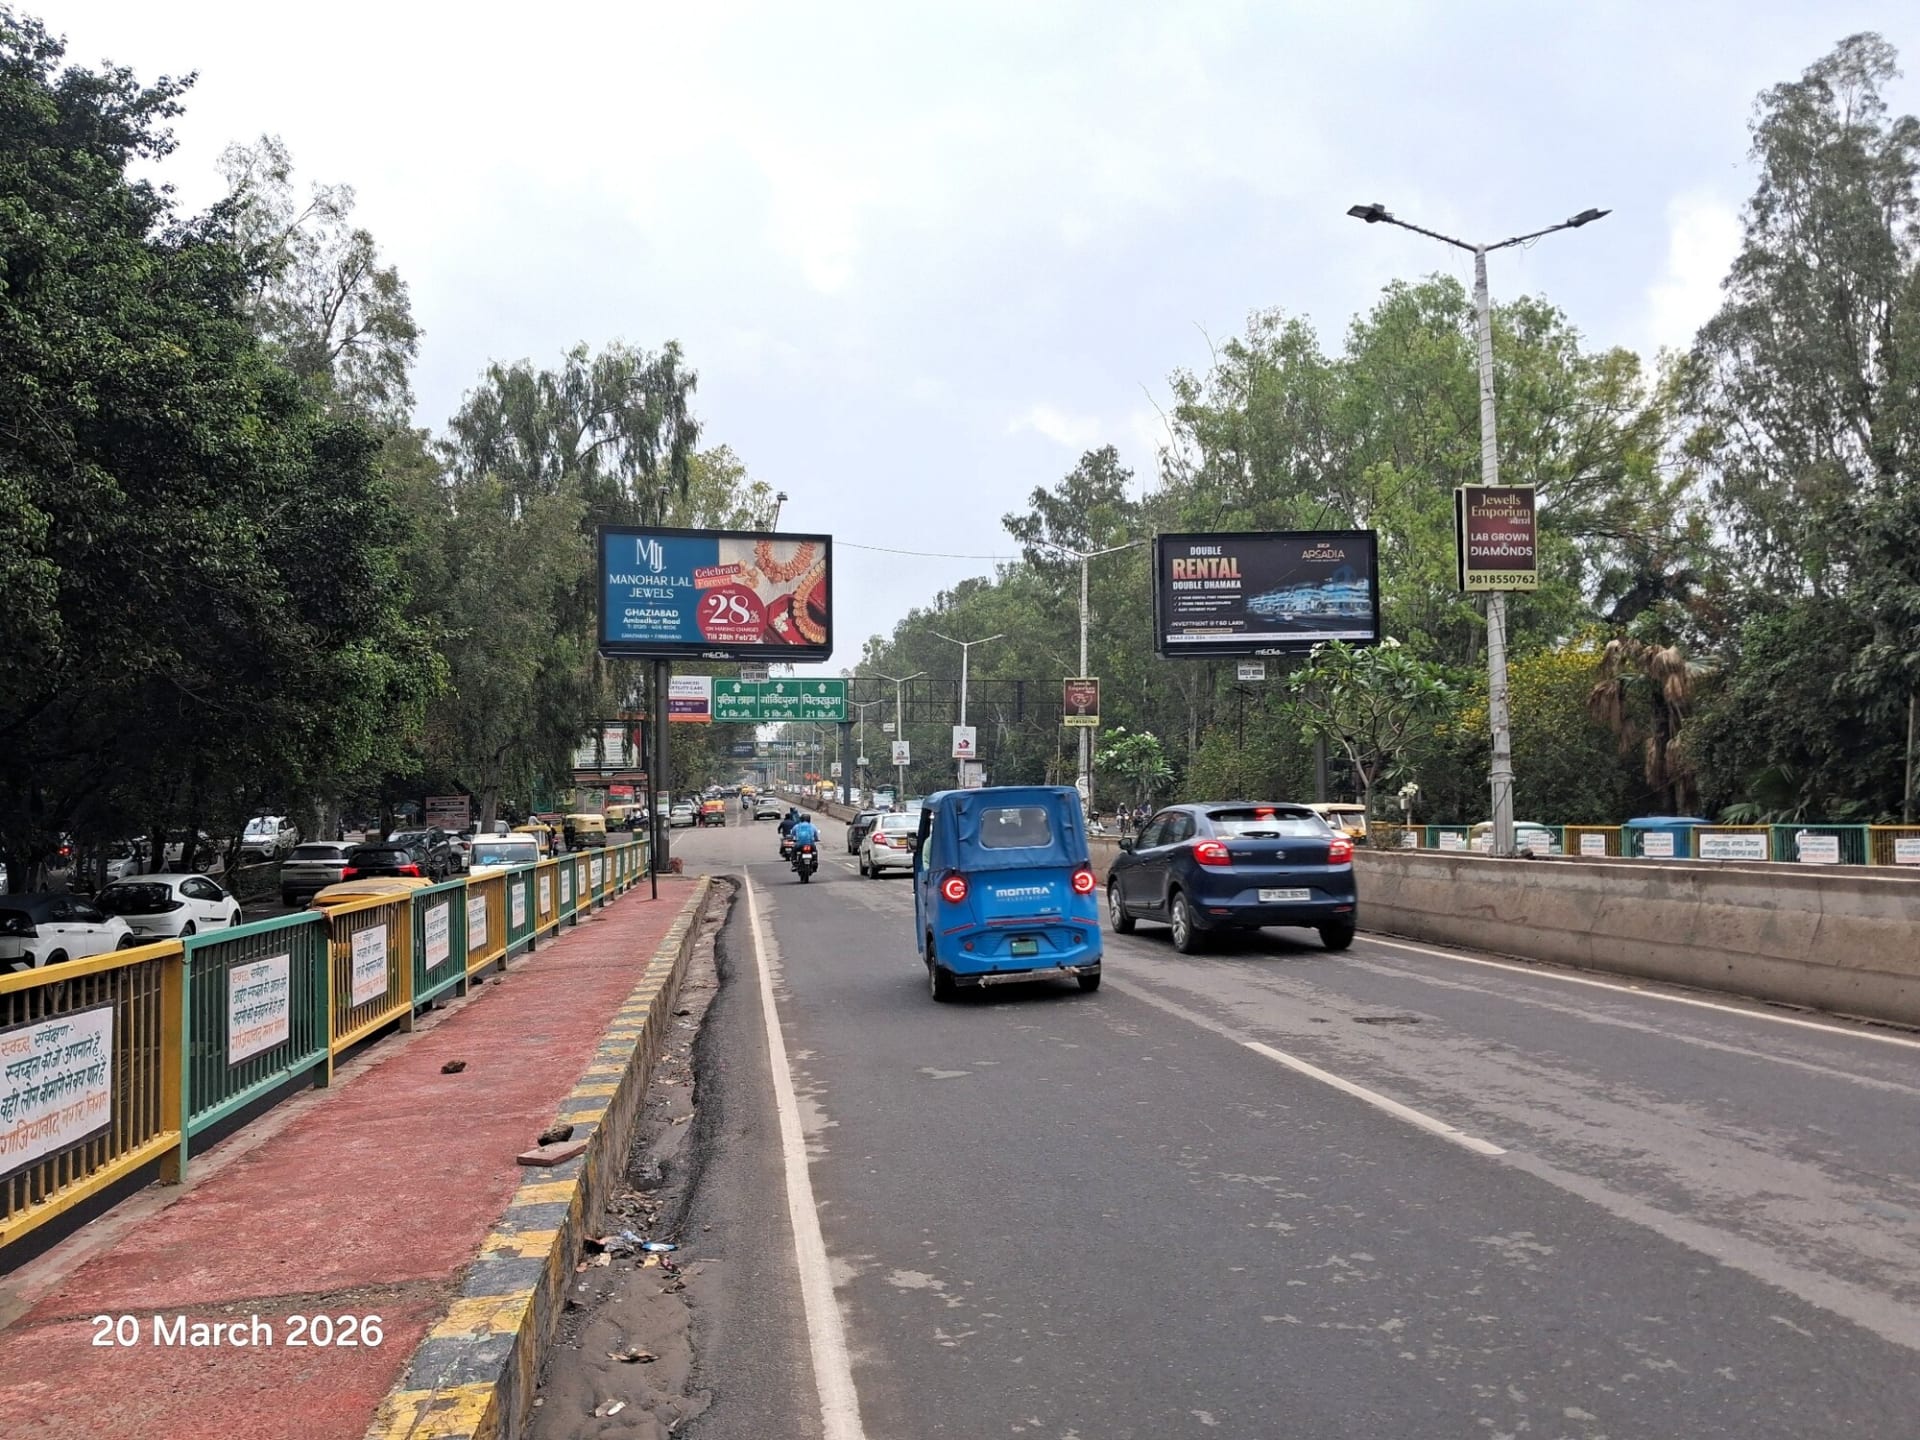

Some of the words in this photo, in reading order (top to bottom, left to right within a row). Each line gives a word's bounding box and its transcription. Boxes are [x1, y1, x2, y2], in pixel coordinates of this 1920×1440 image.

[1482, 494, 1521, 507] Jewells
[1471, 506, 1530, 519] Emporium
[1471, 533, 1488, 541] LAB
[1491, 533, 1529, 541] GROWN
[1190, 546, 1222, 556] DOUBLE
[1471, 546, 1532, 556] DIAMONDS
[695, 565, 739, 578] Celebrate
[1173, 557, 1242, 580] RENTAL
[609, 574, 668, 586] MANOHAR
[671, 577, 692, 587] LAL
[698, 577, 731, 588] Forever
[1173, 581, 1202, 590] DOUBLE
[1204, 580, 1241, 589] DHAMAKA
[1469, 575, 1535, 584] 9818550762
[629, 587, 674, 599] JEWELS
[625, 608, 679, 617] GHAZIABAD
[708, 595, 750, 625] 28
[719, 633, 733, 641] 28th
[41, 1047, 52, 1070] को
[0, 1088, 20, 1123] वही
[20, 1082, 40, 1114] लोग
[62, 1101, 84, 1127] नगर
[86, 1090, 107, 1114] निगम
